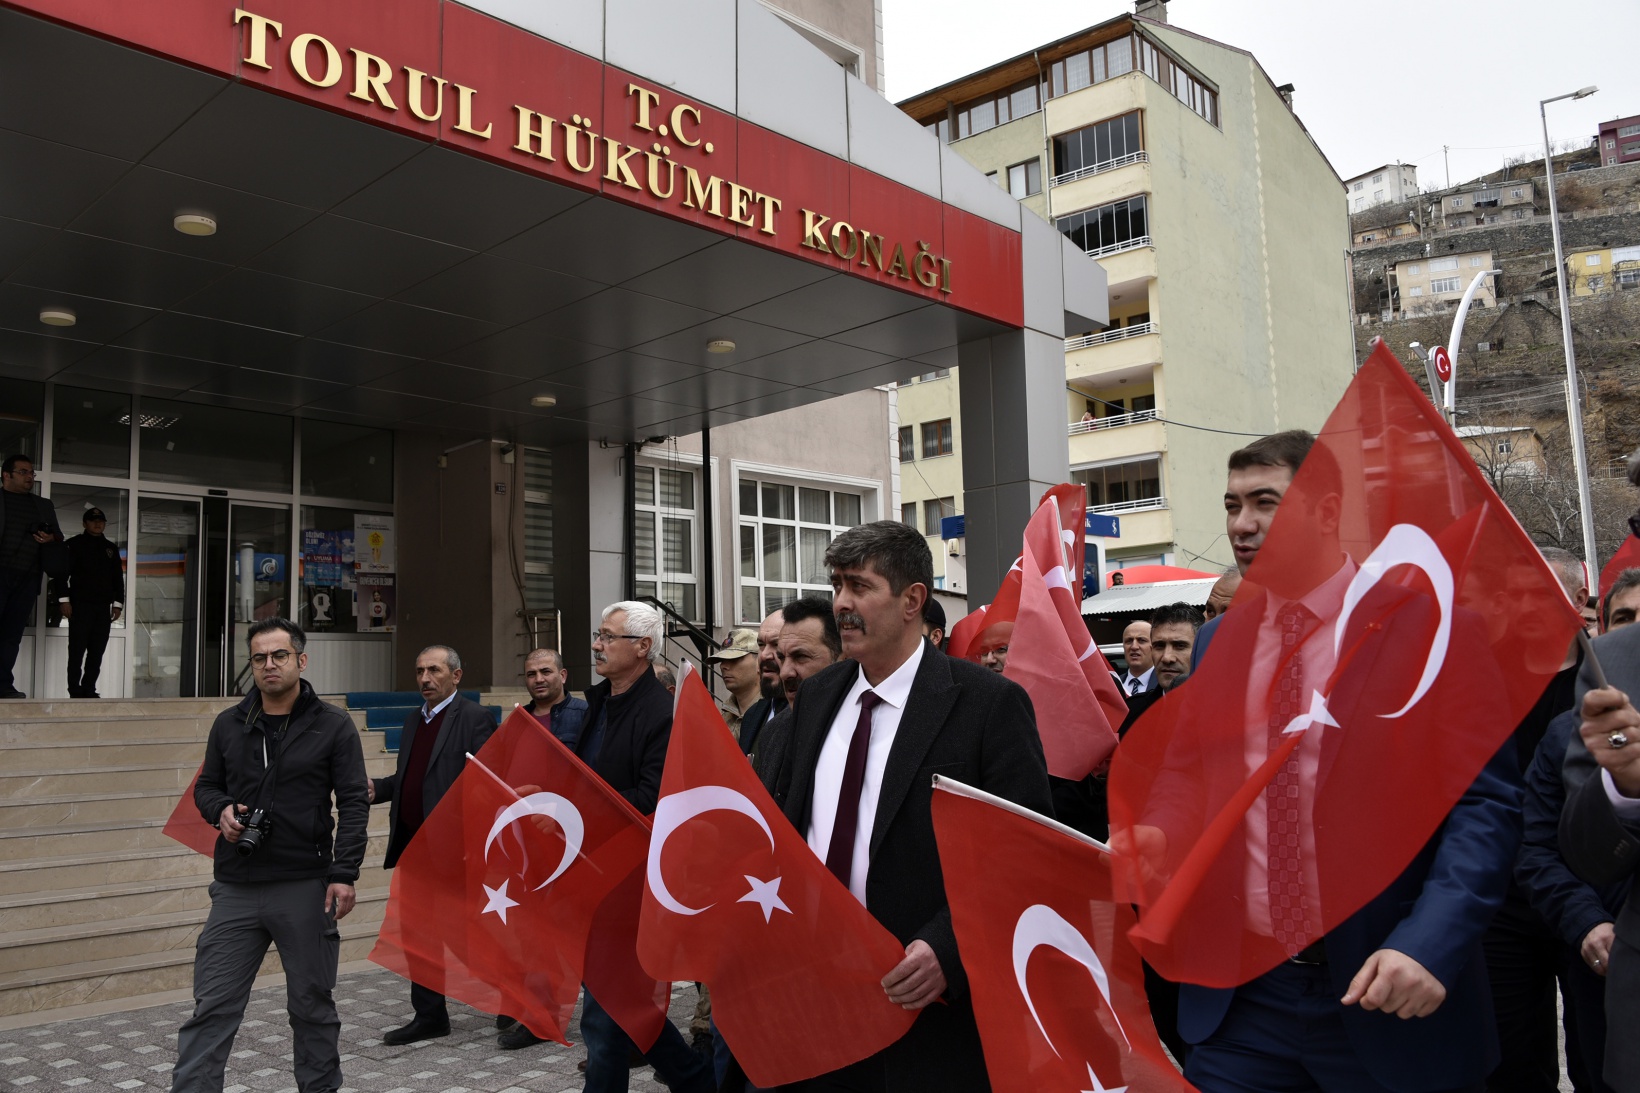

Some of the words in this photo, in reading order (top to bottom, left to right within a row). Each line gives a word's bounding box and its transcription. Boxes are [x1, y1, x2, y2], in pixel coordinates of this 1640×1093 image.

[233, 8, 493, 140] TORUL
[513, 104, 782, 236] HÜKÜMET
[799, 208, 953, 294] KONAĞI
[628, 82, 714, 155] T.C.
